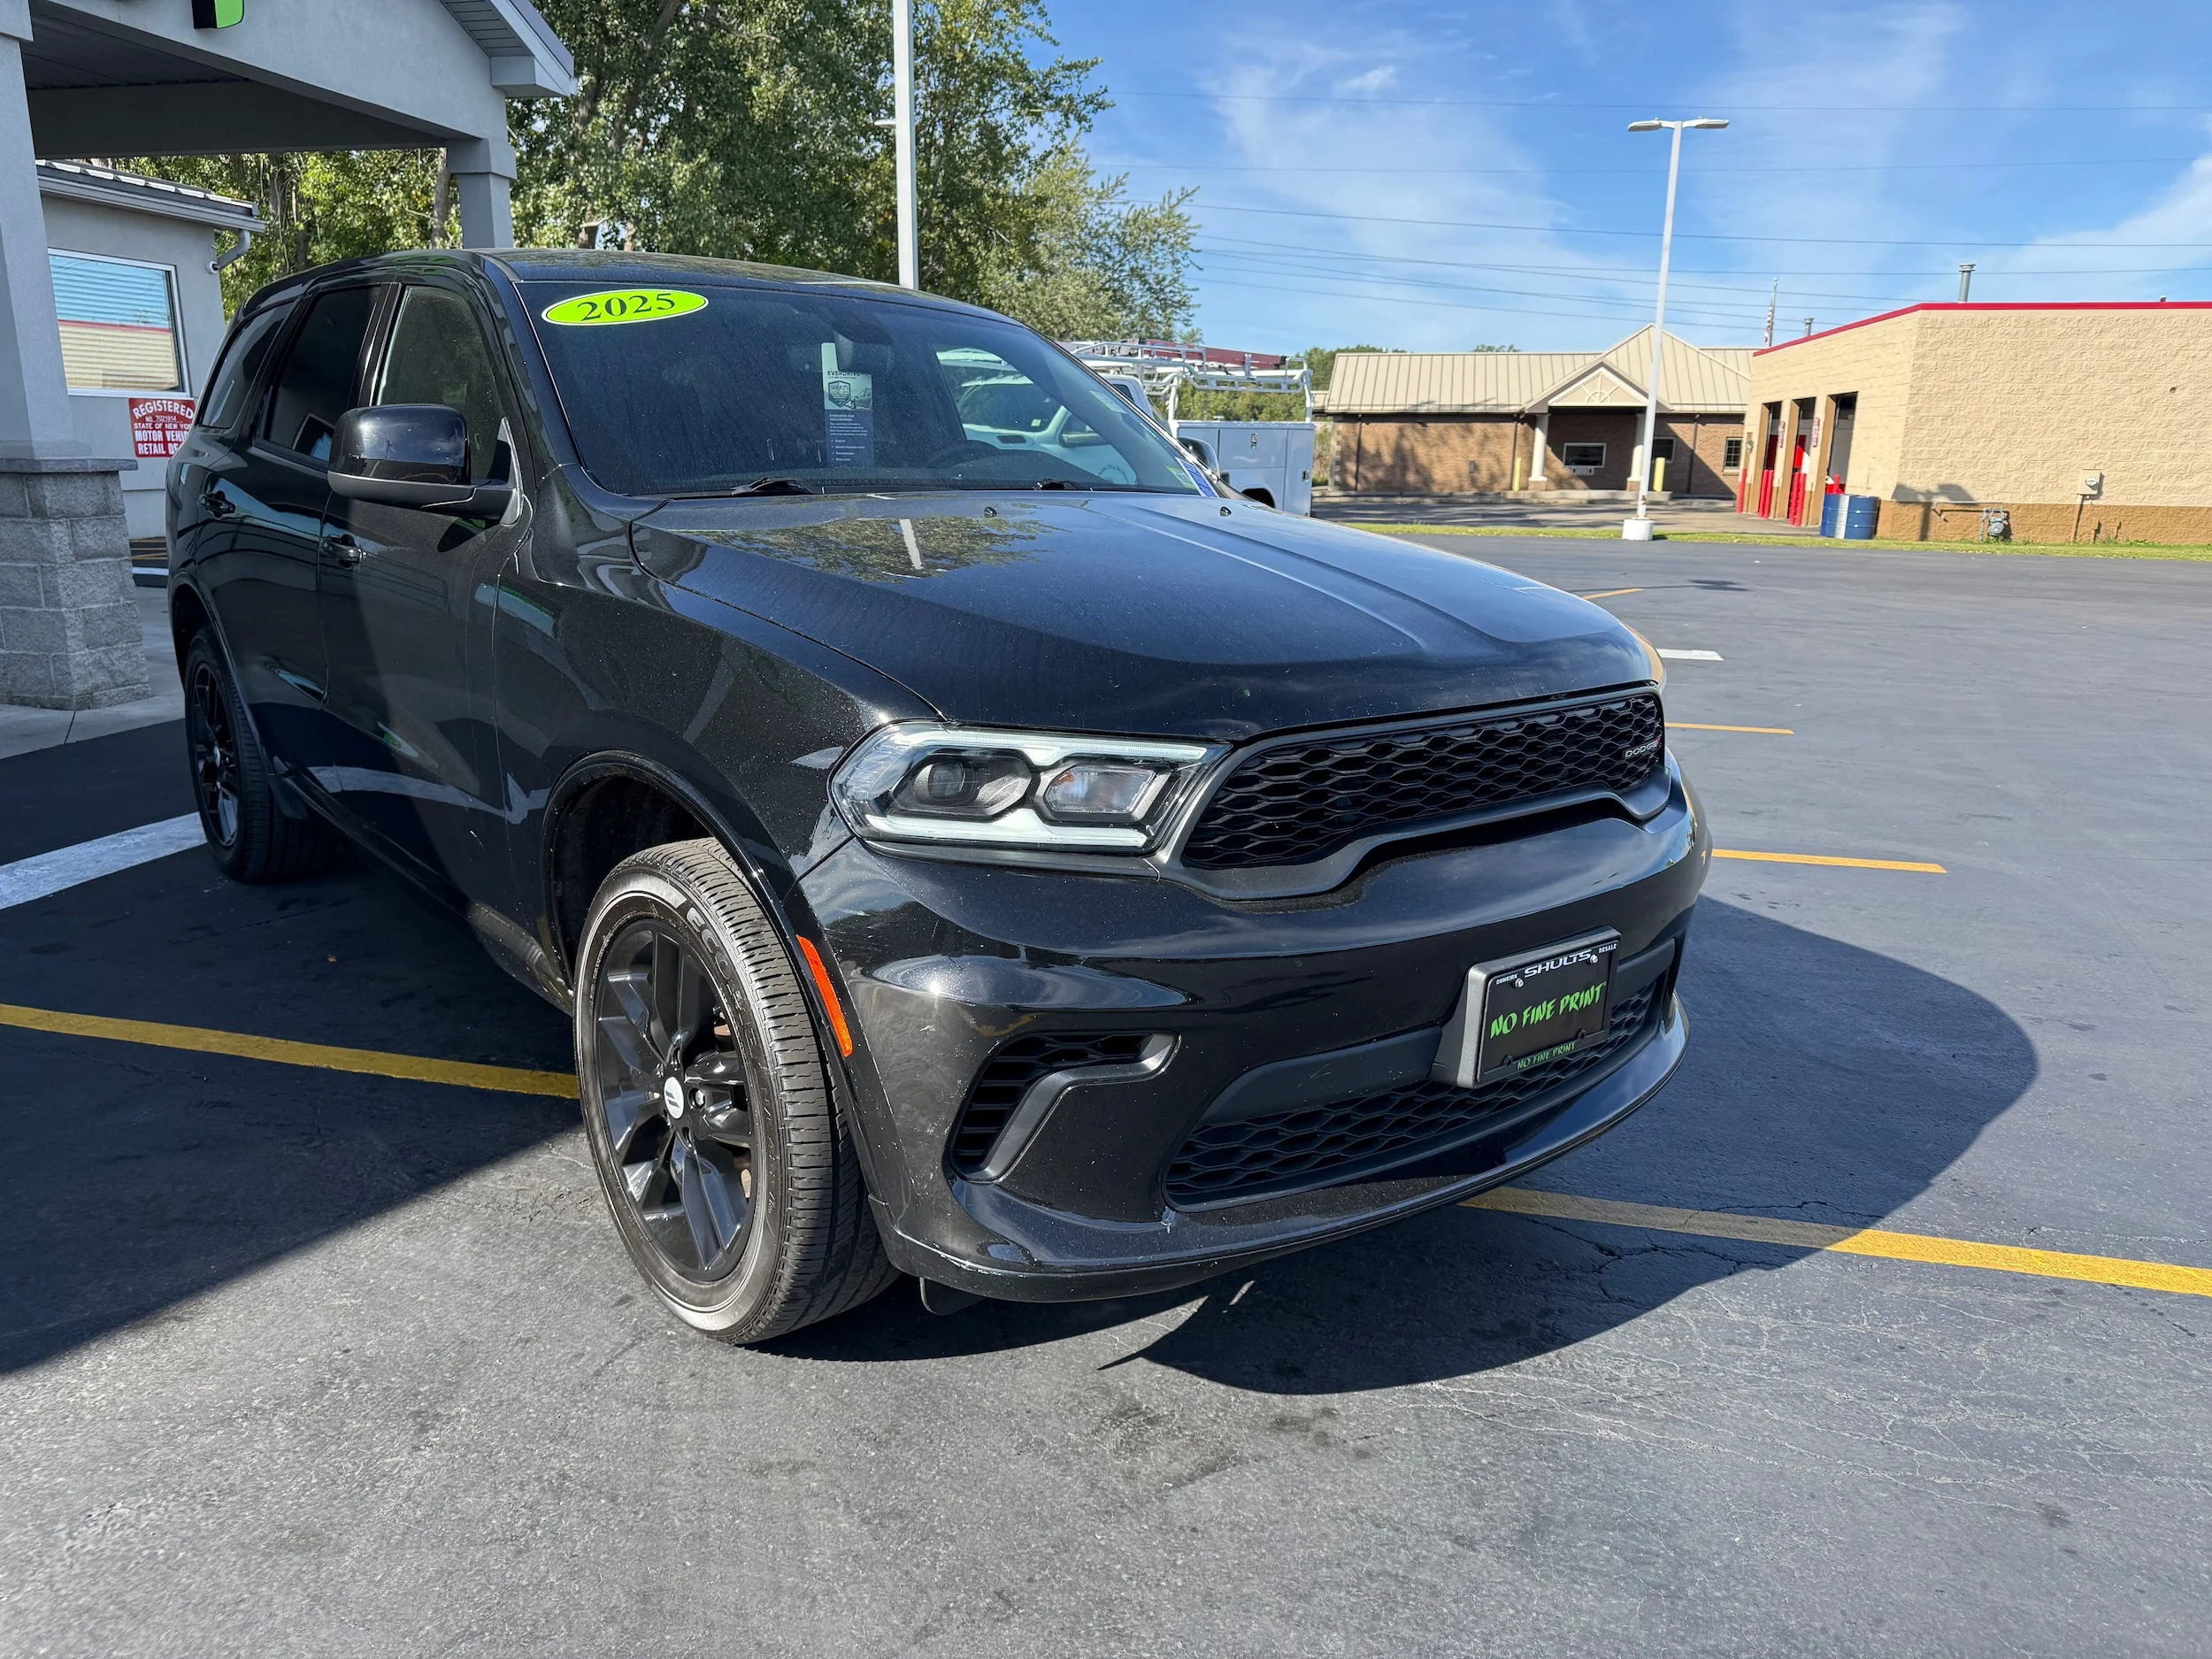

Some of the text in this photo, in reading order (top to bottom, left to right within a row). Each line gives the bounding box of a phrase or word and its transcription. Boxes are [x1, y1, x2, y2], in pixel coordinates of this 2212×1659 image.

[577, 293, 675, 321] 2025
[133, 400, 194, 419] REGISTERED
[134, 430, 163, 442] MOTOR
[138, 443, 166, 455] RETAIL
[1624, 740, 1657, 758] DODGE
[1496, 943, 1617, 986] DUNKIRK SHULTS RESALE
[1490, 982, 1603, 1040] NO FINE PRINT
[1517, 1041, 1576, 1071] NO FINE PRINT
